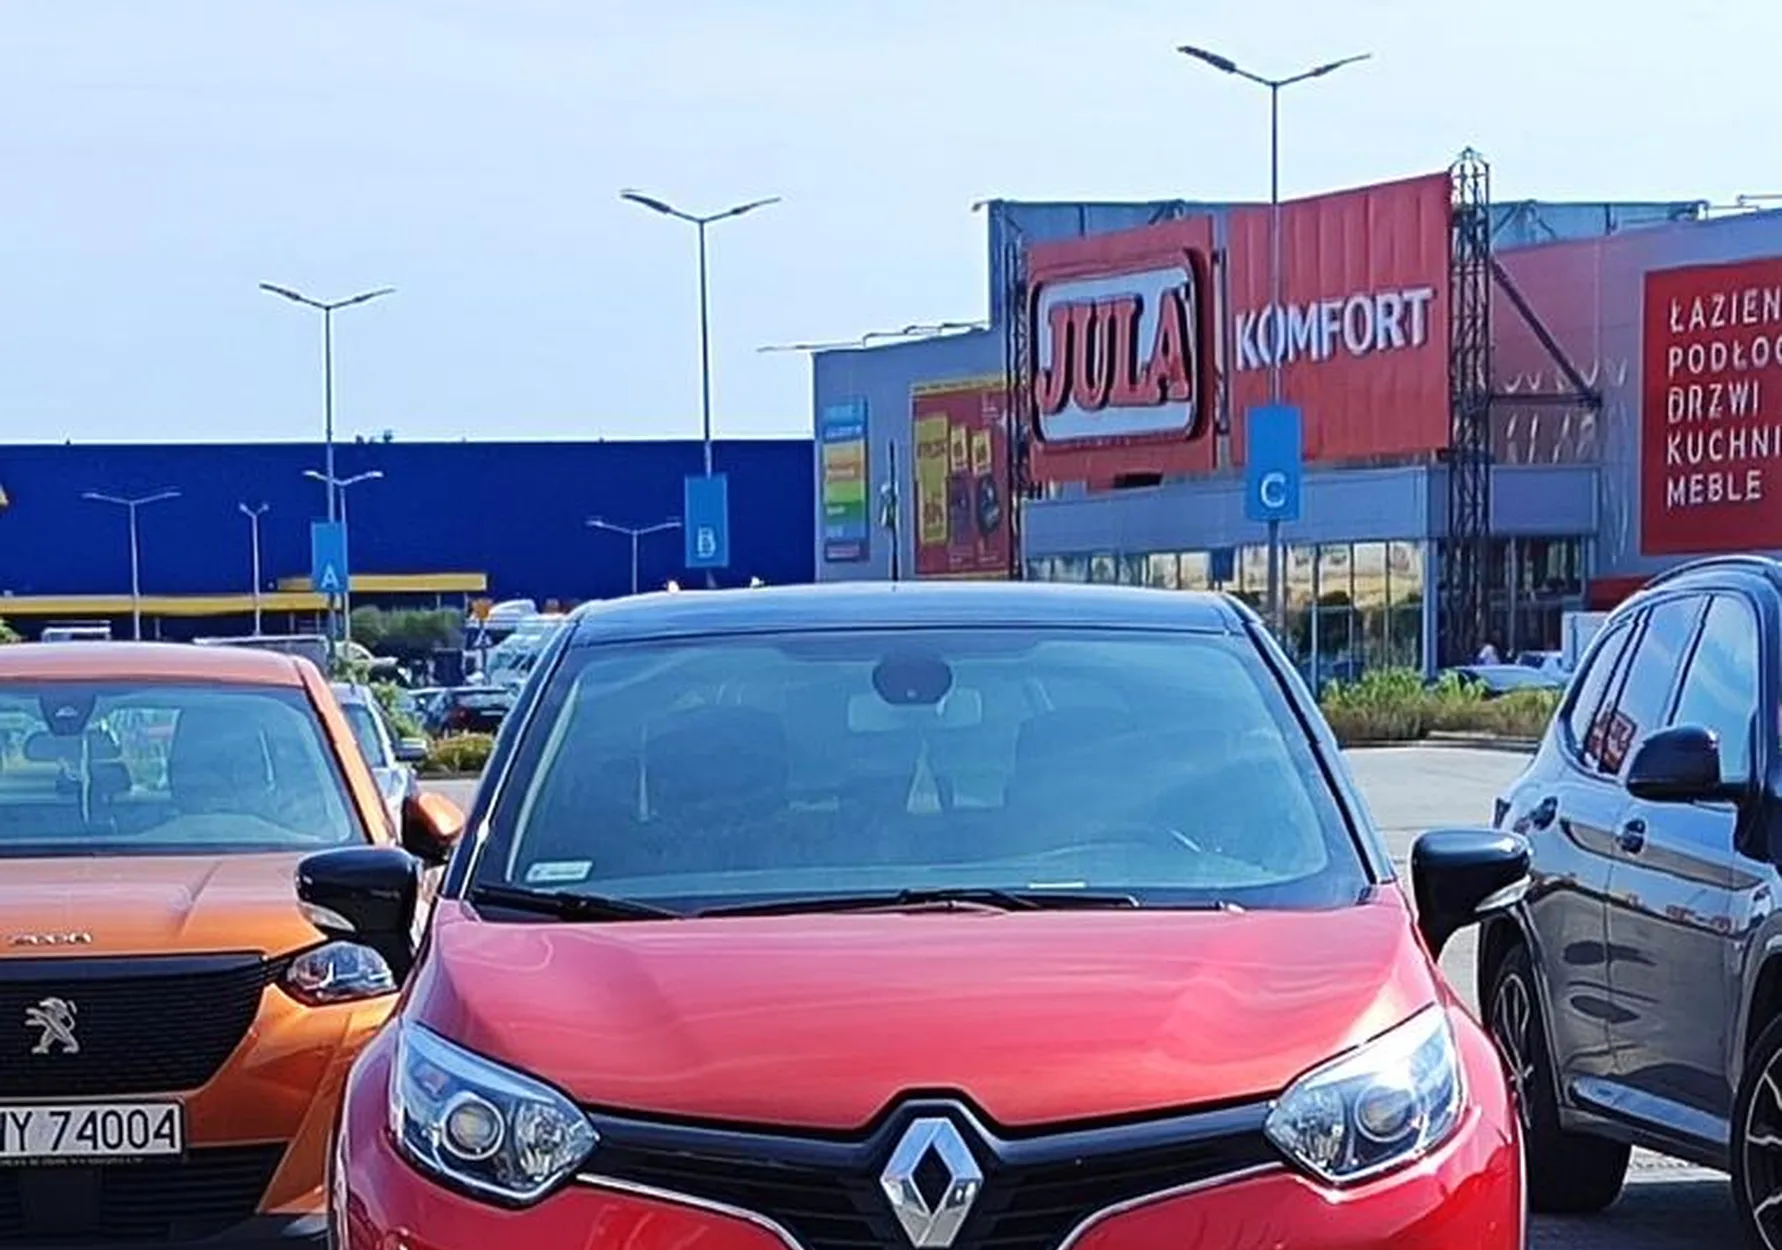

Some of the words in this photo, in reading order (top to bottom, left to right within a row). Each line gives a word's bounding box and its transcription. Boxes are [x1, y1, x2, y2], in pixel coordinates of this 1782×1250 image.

[1235, 287, 1433, 371] KOMFORT
[1669, 286, 1781, 334] ŁAZIEN
[1035, 288, 1190, 414] JULA
[1667, 379, 1760, 423] DRZWI
[1667, 424, 1781, 465] KUCHNI
[1260, 472, 1286, 508] C
[1667, 469, 1762, 508] MEBLE
[697, 527, 716, 558] B
[320, 562, 340, 589] A
[48, 1109, 176, 1151] 74004
